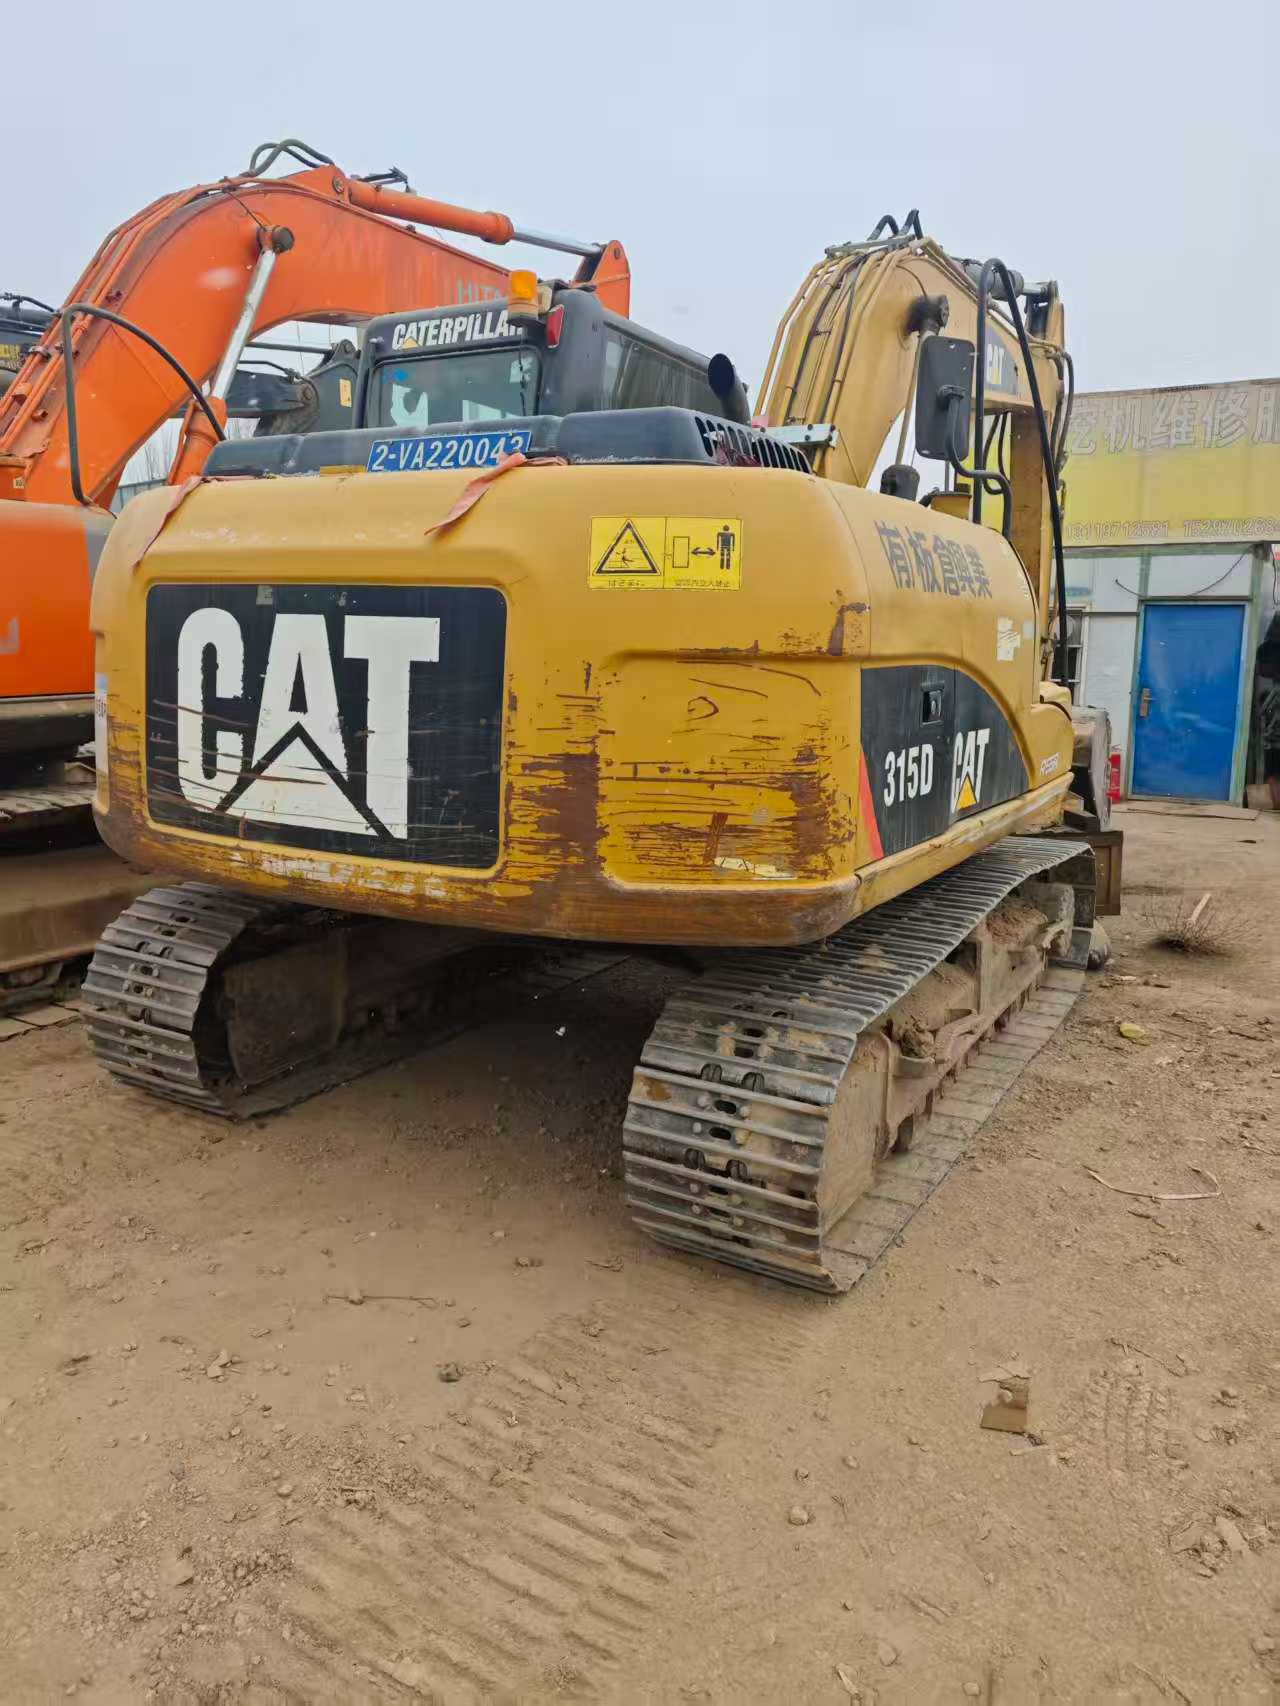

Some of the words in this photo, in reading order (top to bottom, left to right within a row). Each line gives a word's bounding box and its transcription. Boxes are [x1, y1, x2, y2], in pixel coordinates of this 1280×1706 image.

[986, 343, 1006, 385] CAT
[177, 607, 441, 841] CAT
[884, 743, 934, 807] 315D
[951, 727, 990, 814] CAT
